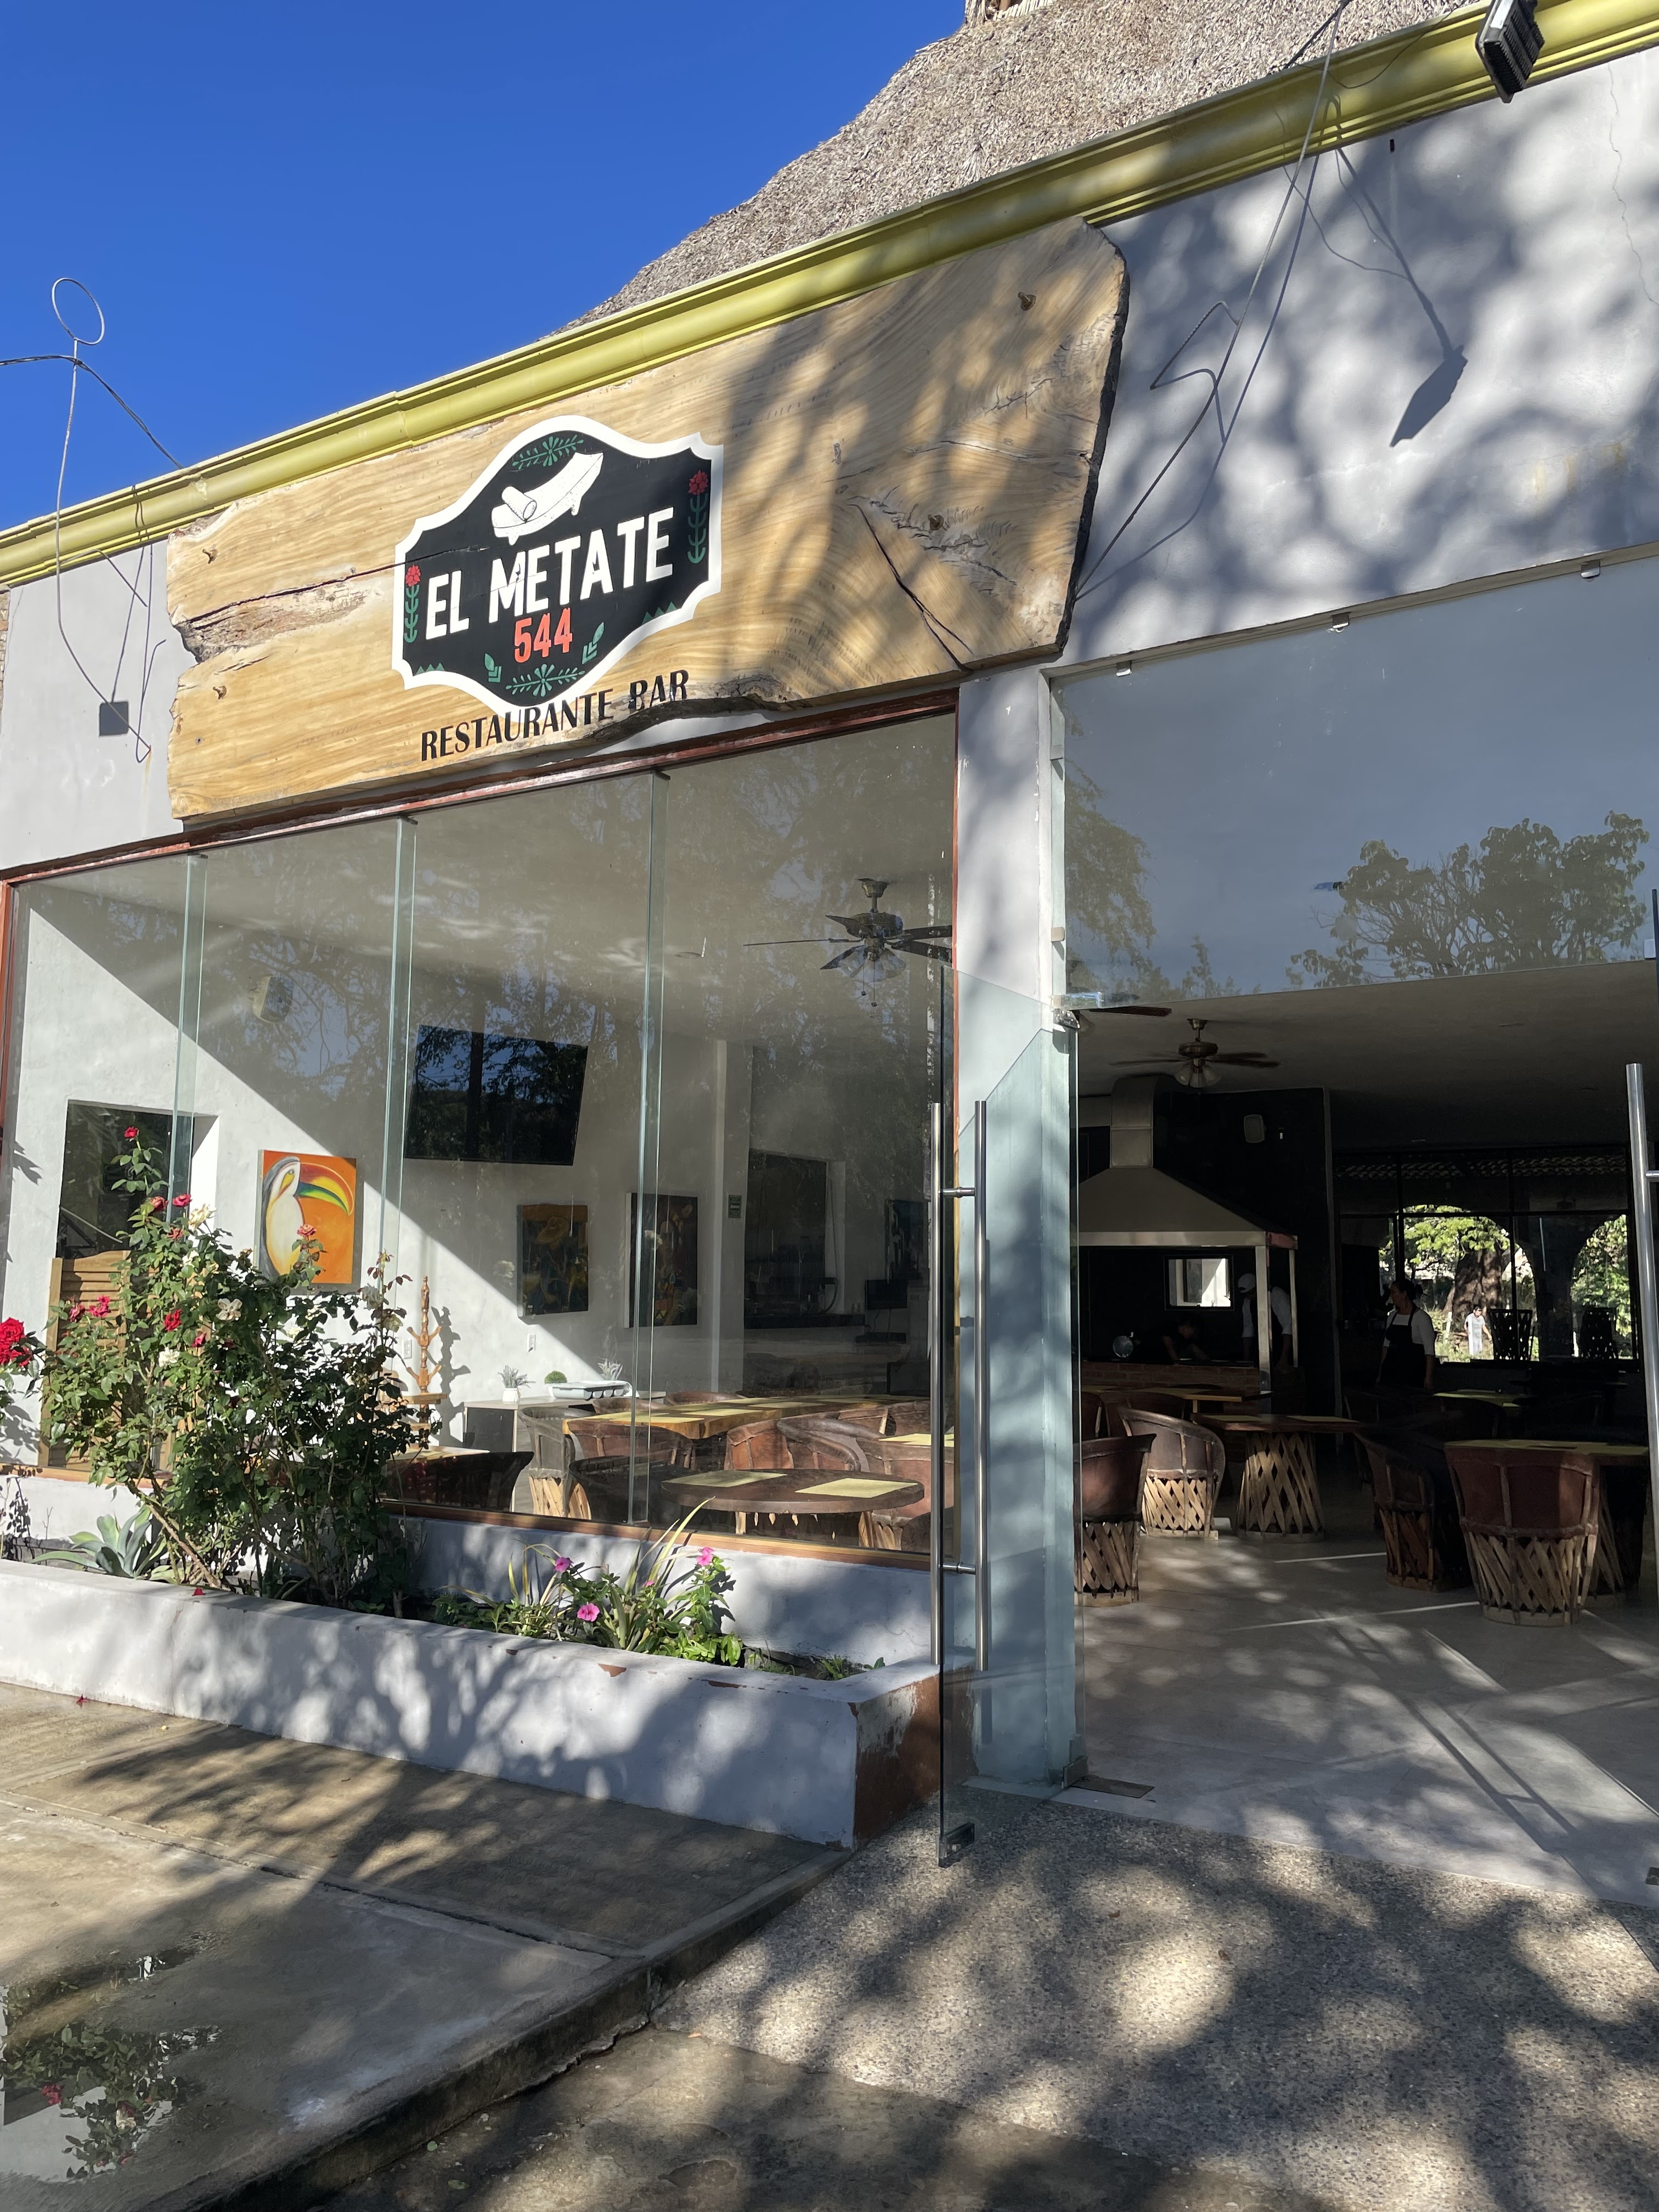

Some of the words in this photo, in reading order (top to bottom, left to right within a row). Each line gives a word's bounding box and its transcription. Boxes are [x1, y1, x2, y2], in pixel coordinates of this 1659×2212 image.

[425, 570, 470, 640] EL
[489, 507, 674, 623] METATE
[514, 607, 573, 663] 544
[421, 689, 614, 761] RESTAURANTE
[629, 669, 689, 710] BAR
